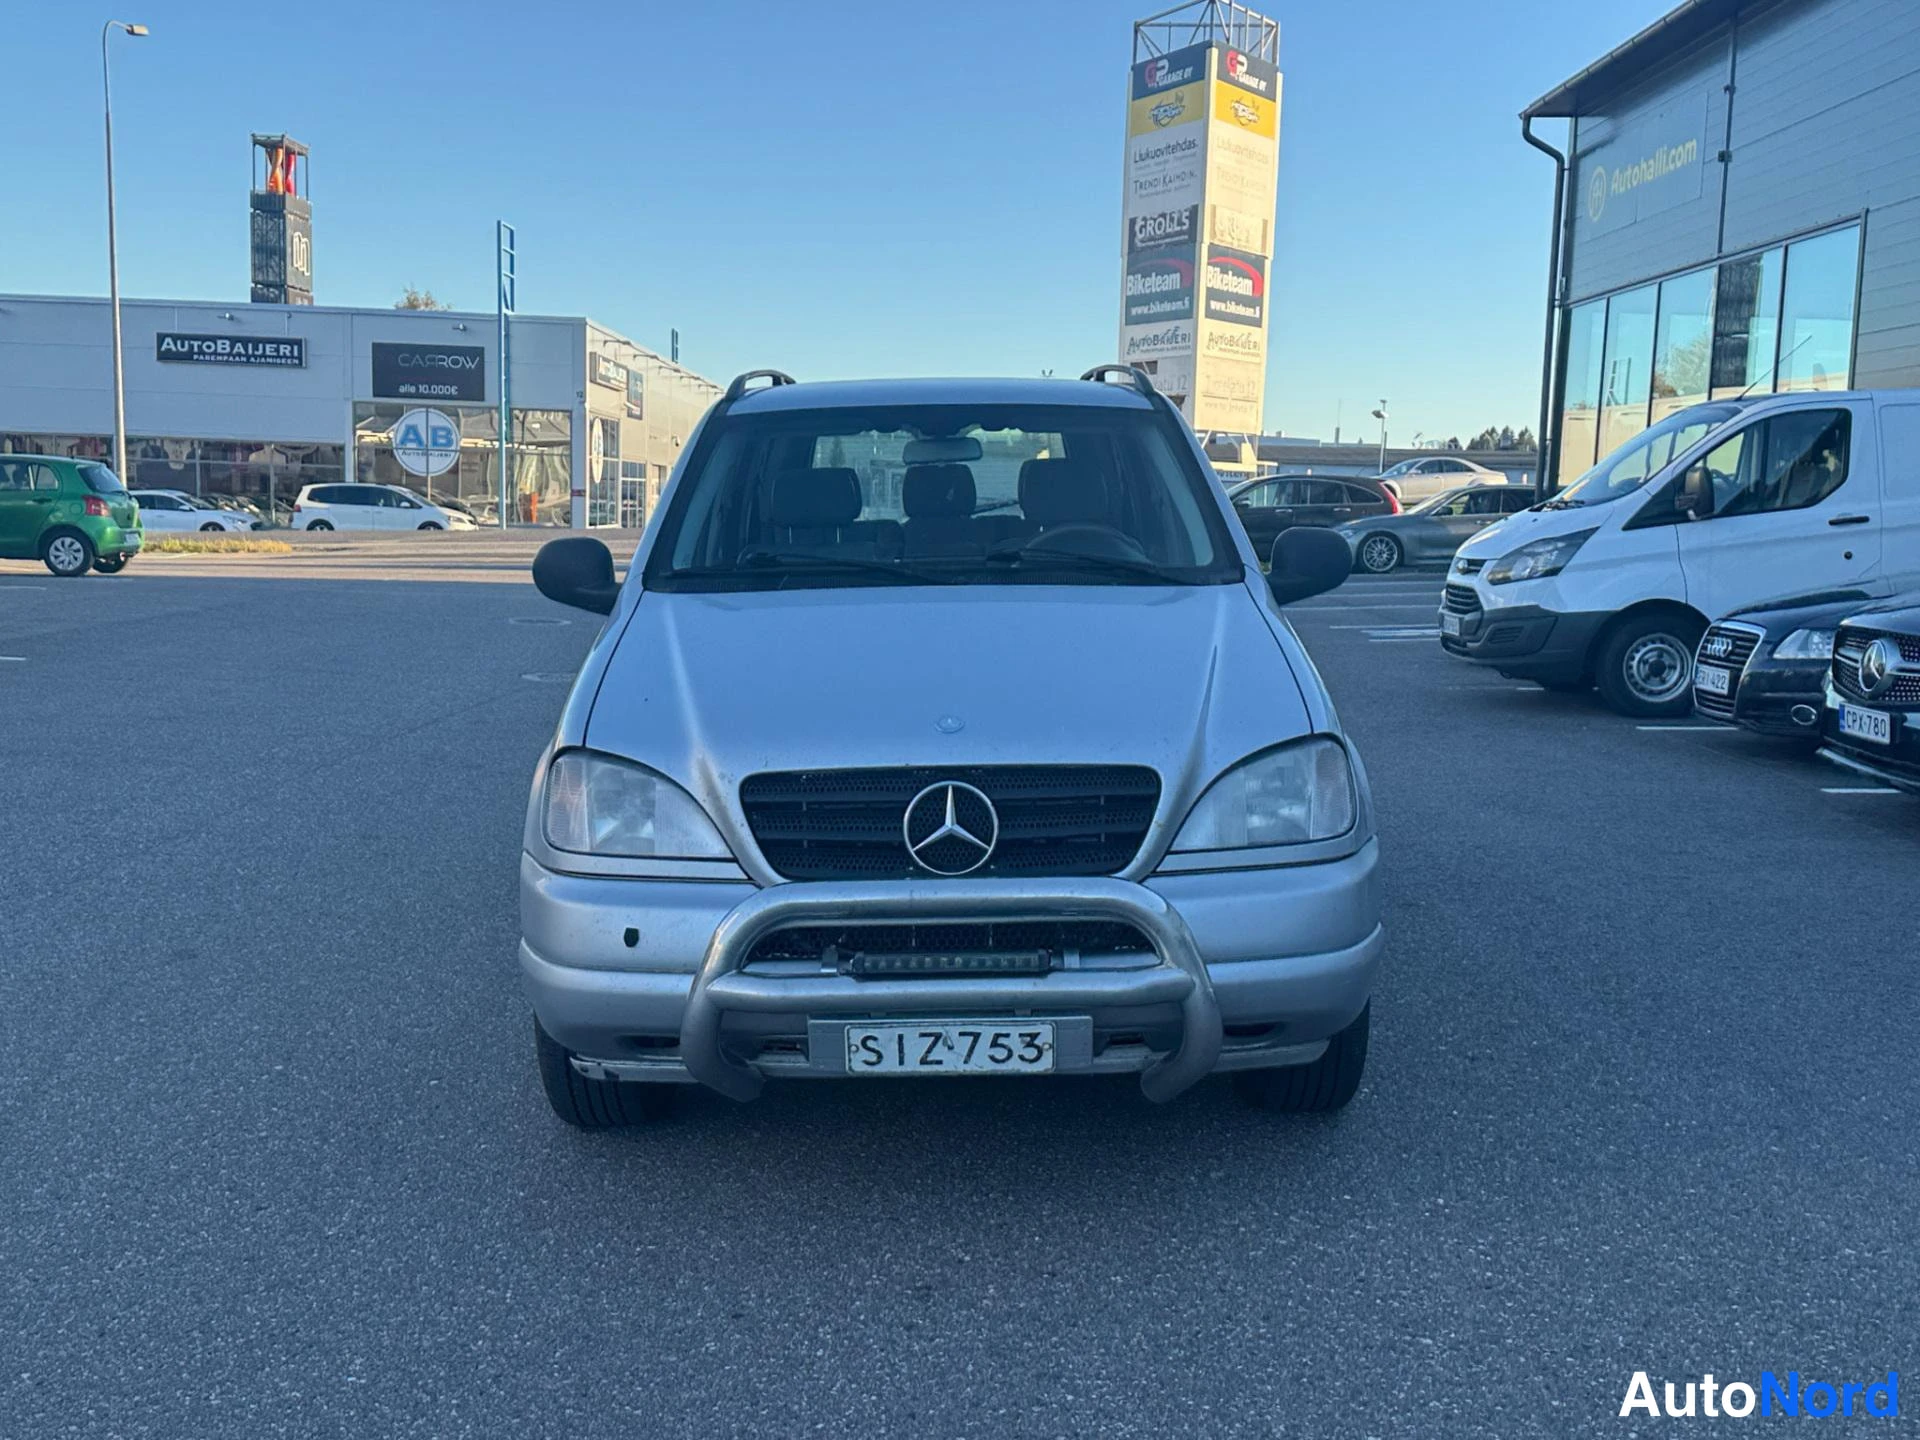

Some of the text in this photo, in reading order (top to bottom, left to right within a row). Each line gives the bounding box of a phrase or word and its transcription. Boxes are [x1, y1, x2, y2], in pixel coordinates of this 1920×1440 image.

[1611, 138, 1697, 194] Autohalli.com
[1135, 210, 1190, 239] GROLLS
[1126, 271, 1180, 296] Biketeam
[1206, 265, 1253, 296] Biketeam
[1131, 296, 1190, 316] www.biketeam.fi
[399, 384, 458, 395] alle 10.000€
[1847, 710, 1887, 737] CPX-780
